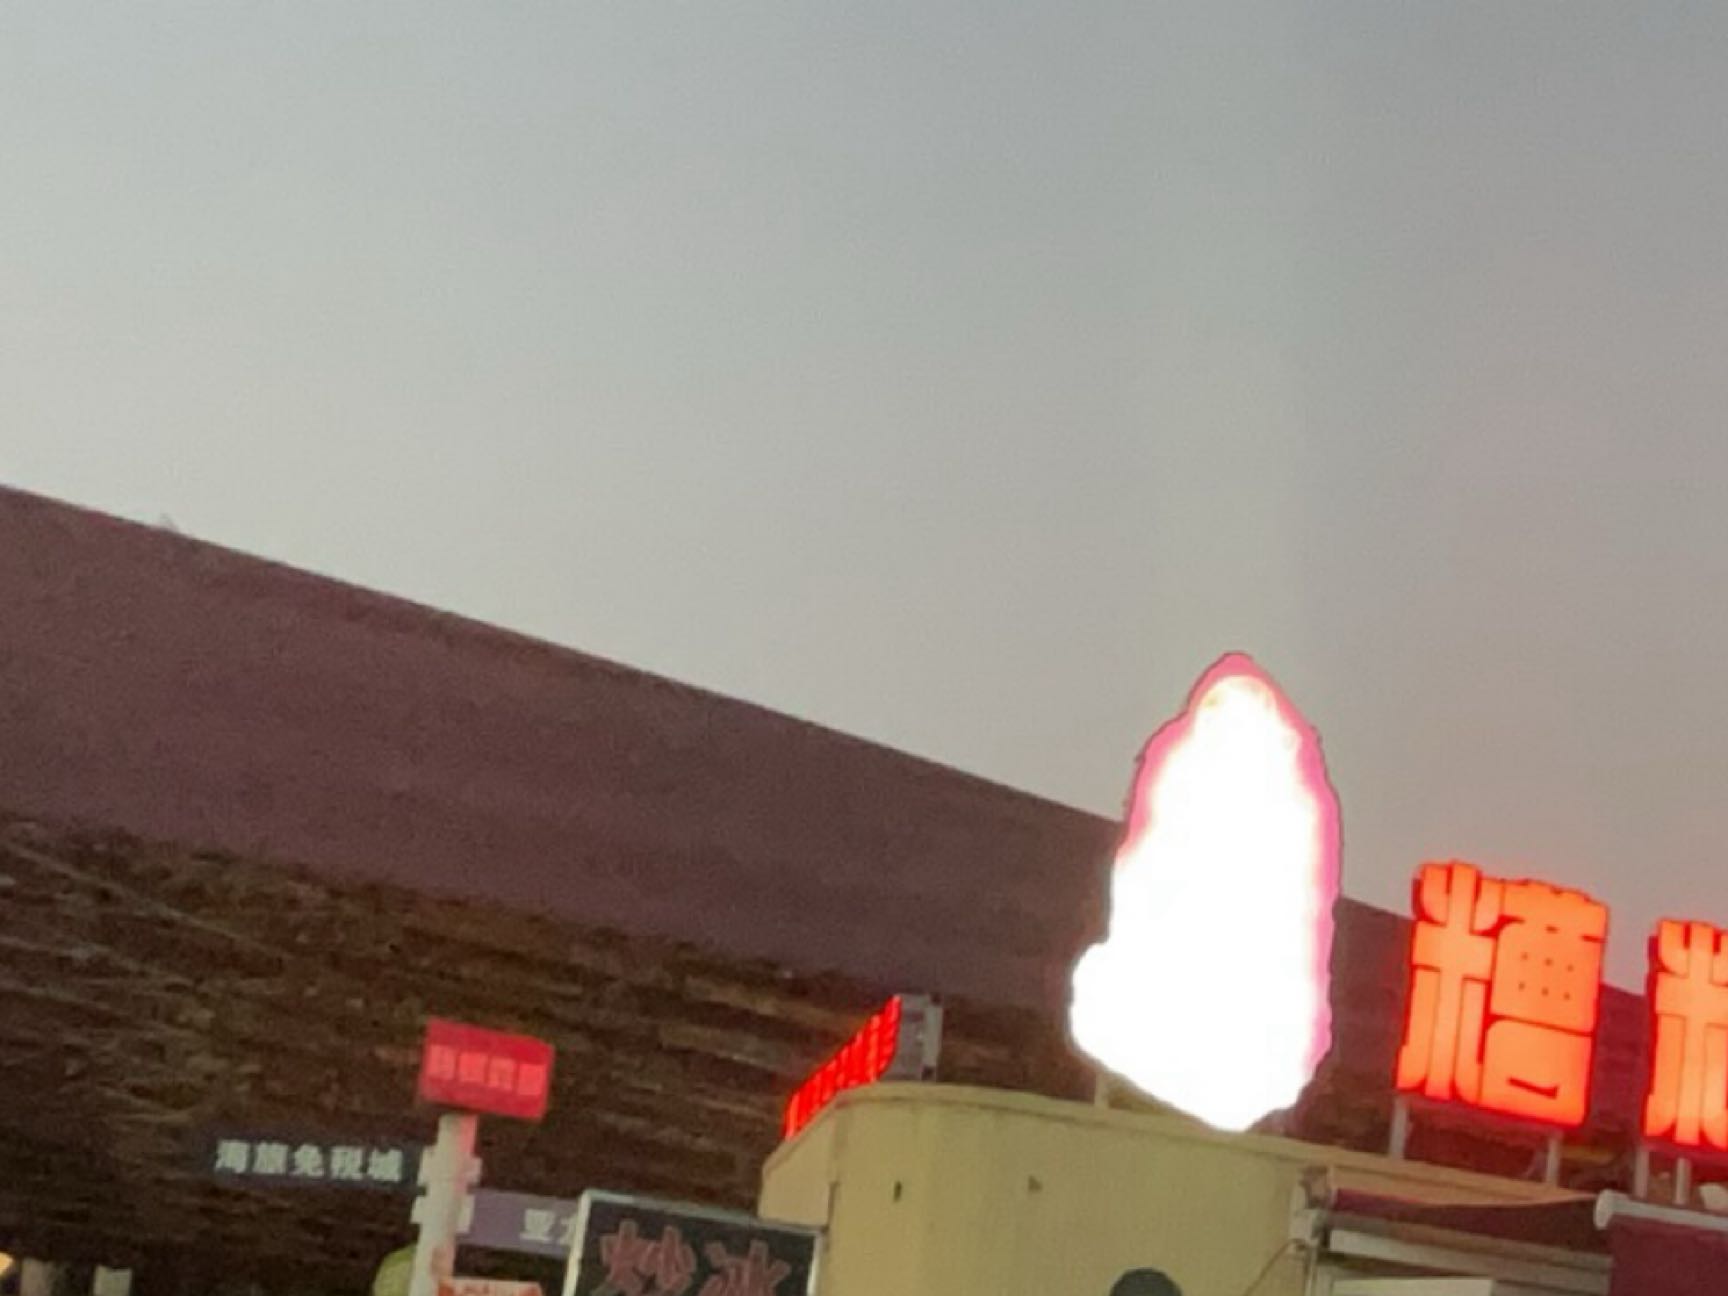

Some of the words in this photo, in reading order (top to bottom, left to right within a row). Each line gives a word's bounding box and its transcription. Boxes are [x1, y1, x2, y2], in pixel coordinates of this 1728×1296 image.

[215, 1139, 402, 1182] 海旅免税城
